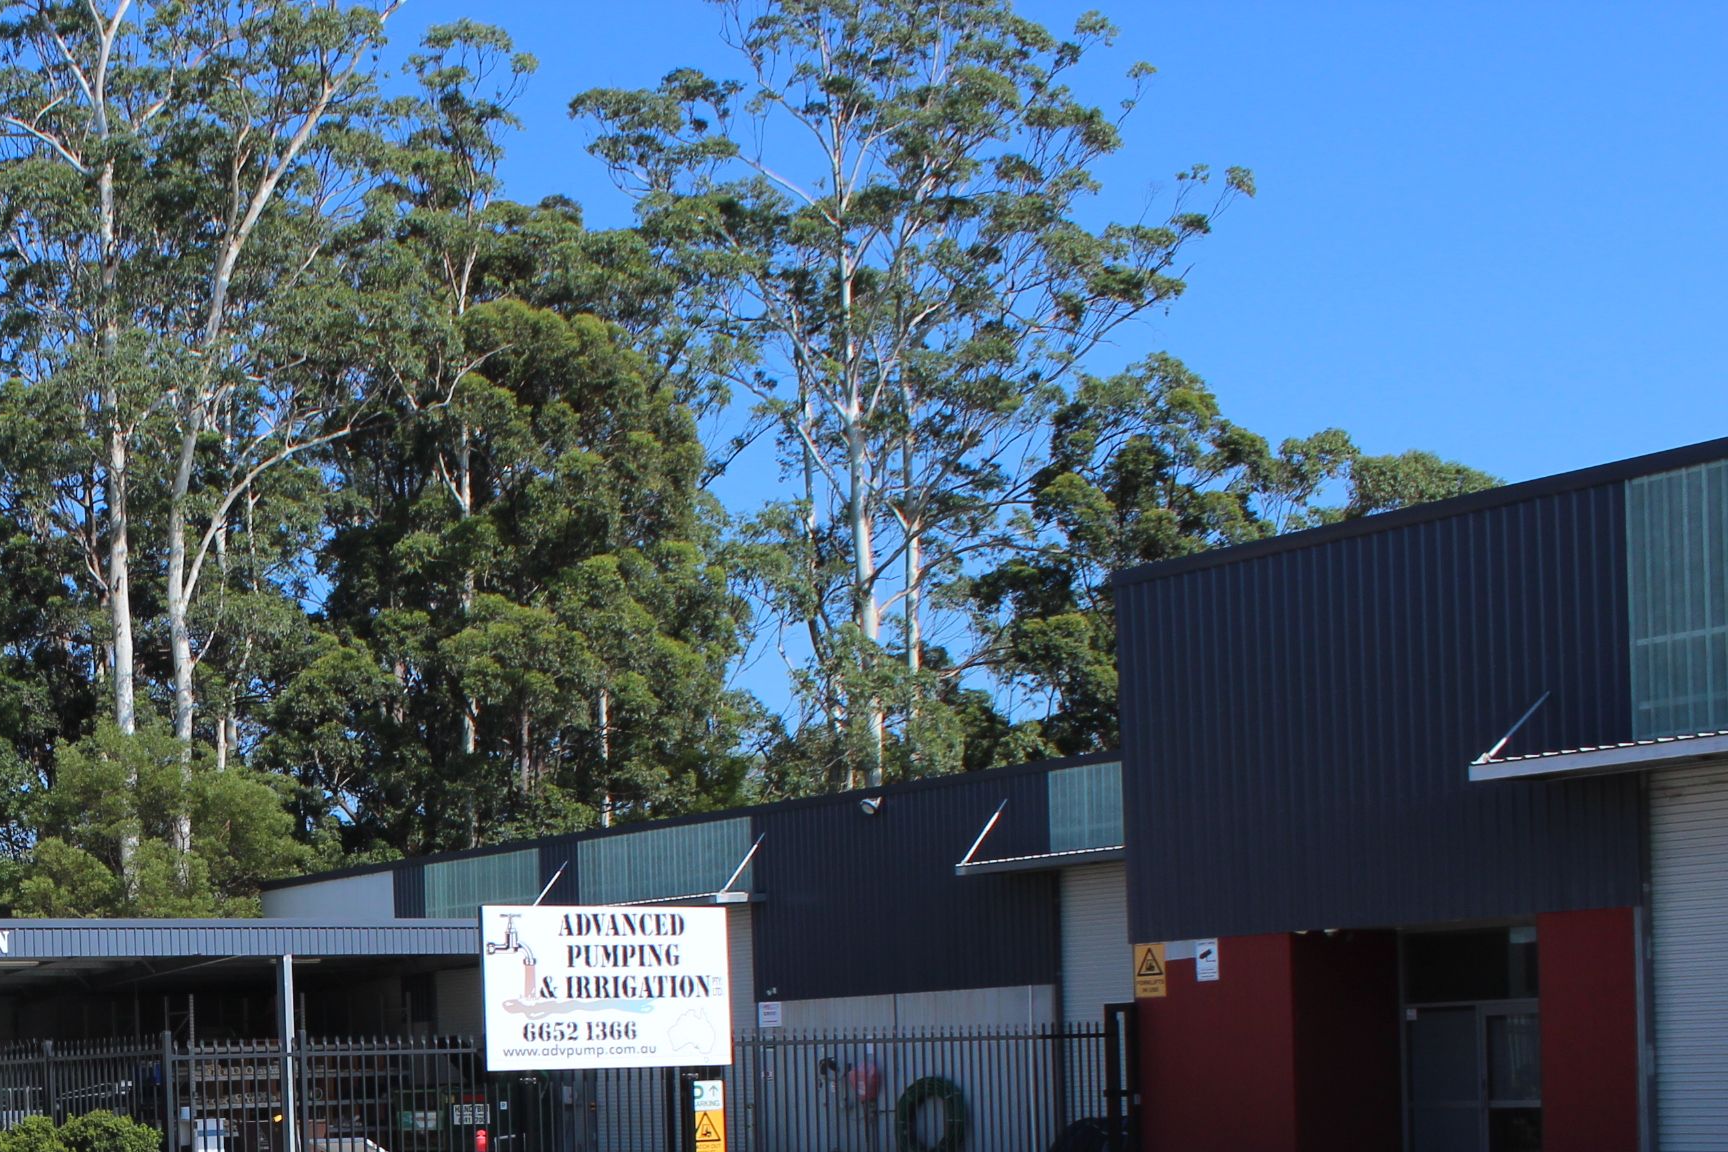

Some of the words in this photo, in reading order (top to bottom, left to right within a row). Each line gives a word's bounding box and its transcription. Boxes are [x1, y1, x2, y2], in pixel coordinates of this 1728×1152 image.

[559, 913, 685, 937] ADVANCED
[566, 944, 680, 968] PUMPING
[539, 975, 558, 999] &
[565, 974, 711, 999] IRRIGATION
[522, 1021, 579, 1042] 6652
[585, 1021, 638, 1041] 1366
[503, 1044, 657, 1058] www.advpump.com.au
[696, 1099, 721, 1107] ARKING
